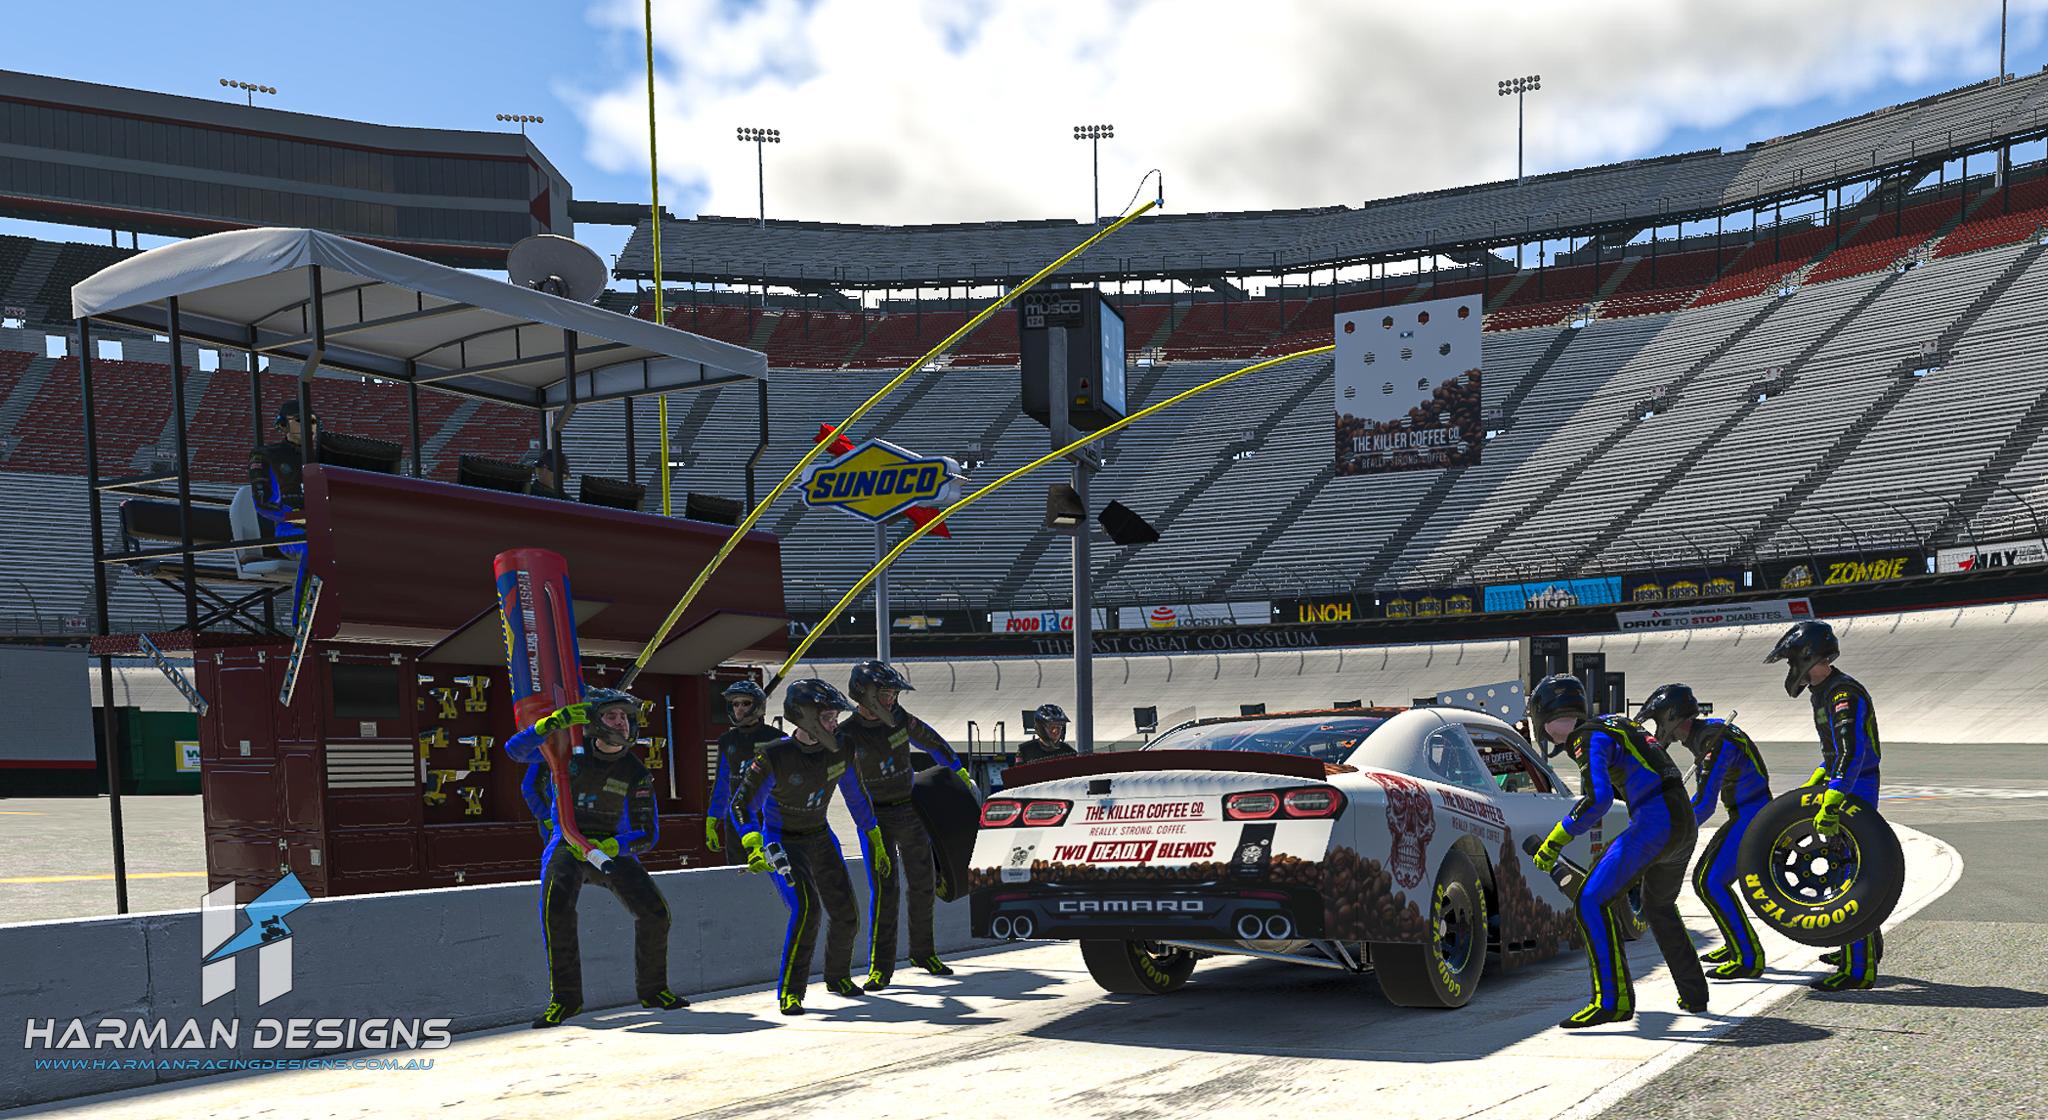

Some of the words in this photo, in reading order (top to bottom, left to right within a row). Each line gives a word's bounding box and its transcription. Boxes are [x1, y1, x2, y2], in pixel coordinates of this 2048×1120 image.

[1353, 434, 1371, 452] THE
[1373, 432, 1407, 451] KILLER
[1409, 428, 1446, 447] COFFEE
[812, 467, 938, 498] SUNOCO
[1824, 557, 1908, 585] ZOMBIE
[1178, 616, 1237, 627] LOGISTICS
[1299, 603, 1351, 622] UNOH
[1623, 618, 1672, 629] DRIVE
[1674, 617, 1689, 626] TO
[1692, 615, 1723, 625] STOP
[1006, 617, 1039, 631] FOOD
[1033, 640, 1073, 653] THE
[1089, 638, 1121, 652] AST
[1128, 635, 1189, 652] GREAT
[1197, 631, 1319, 650] COLOSSEUM
[1085, 805, 1105, 821] THE
[1107, 803, 1145, 820] KILLER
[1146, 802, 1188, 819] COFFEE
[1801, 793, 1862, 817] EALE
[1089, 826, 1118, 836] REALLY.
[1120, 825, 1154, 835] STRONG.
[1156, 824, 1187, 835] COFFEE.
[1052, 845, 1087, 861] TWO
[1091, 842, 1153, 860] DEADLY
[1157, 842, 1217, 858] BLENDS
[1059, 900, 1204, 912] CAMARO
[1745, 873, 1859, 930] GOODYEAR
